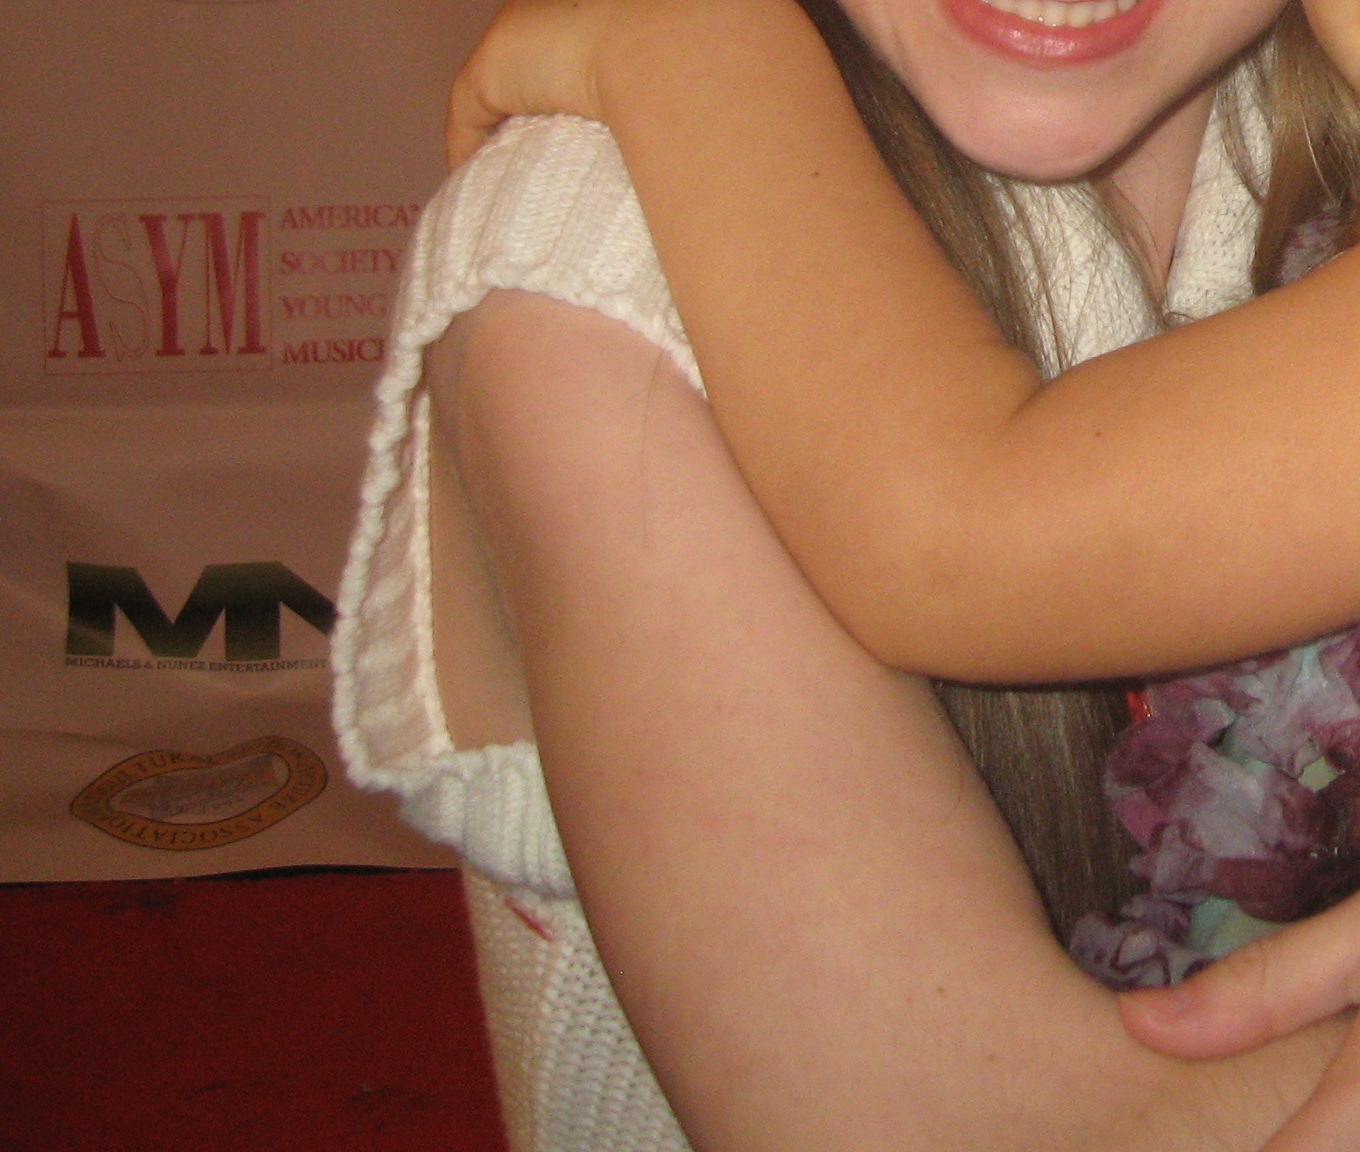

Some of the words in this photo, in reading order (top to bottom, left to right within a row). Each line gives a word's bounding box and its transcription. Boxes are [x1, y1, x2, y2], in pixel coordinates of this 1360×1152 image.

[281, 249, 402, 274] SOCIETY
[281, 294, 388, 319] YOUNG
[282, 338, 386, 365] MUSICI
